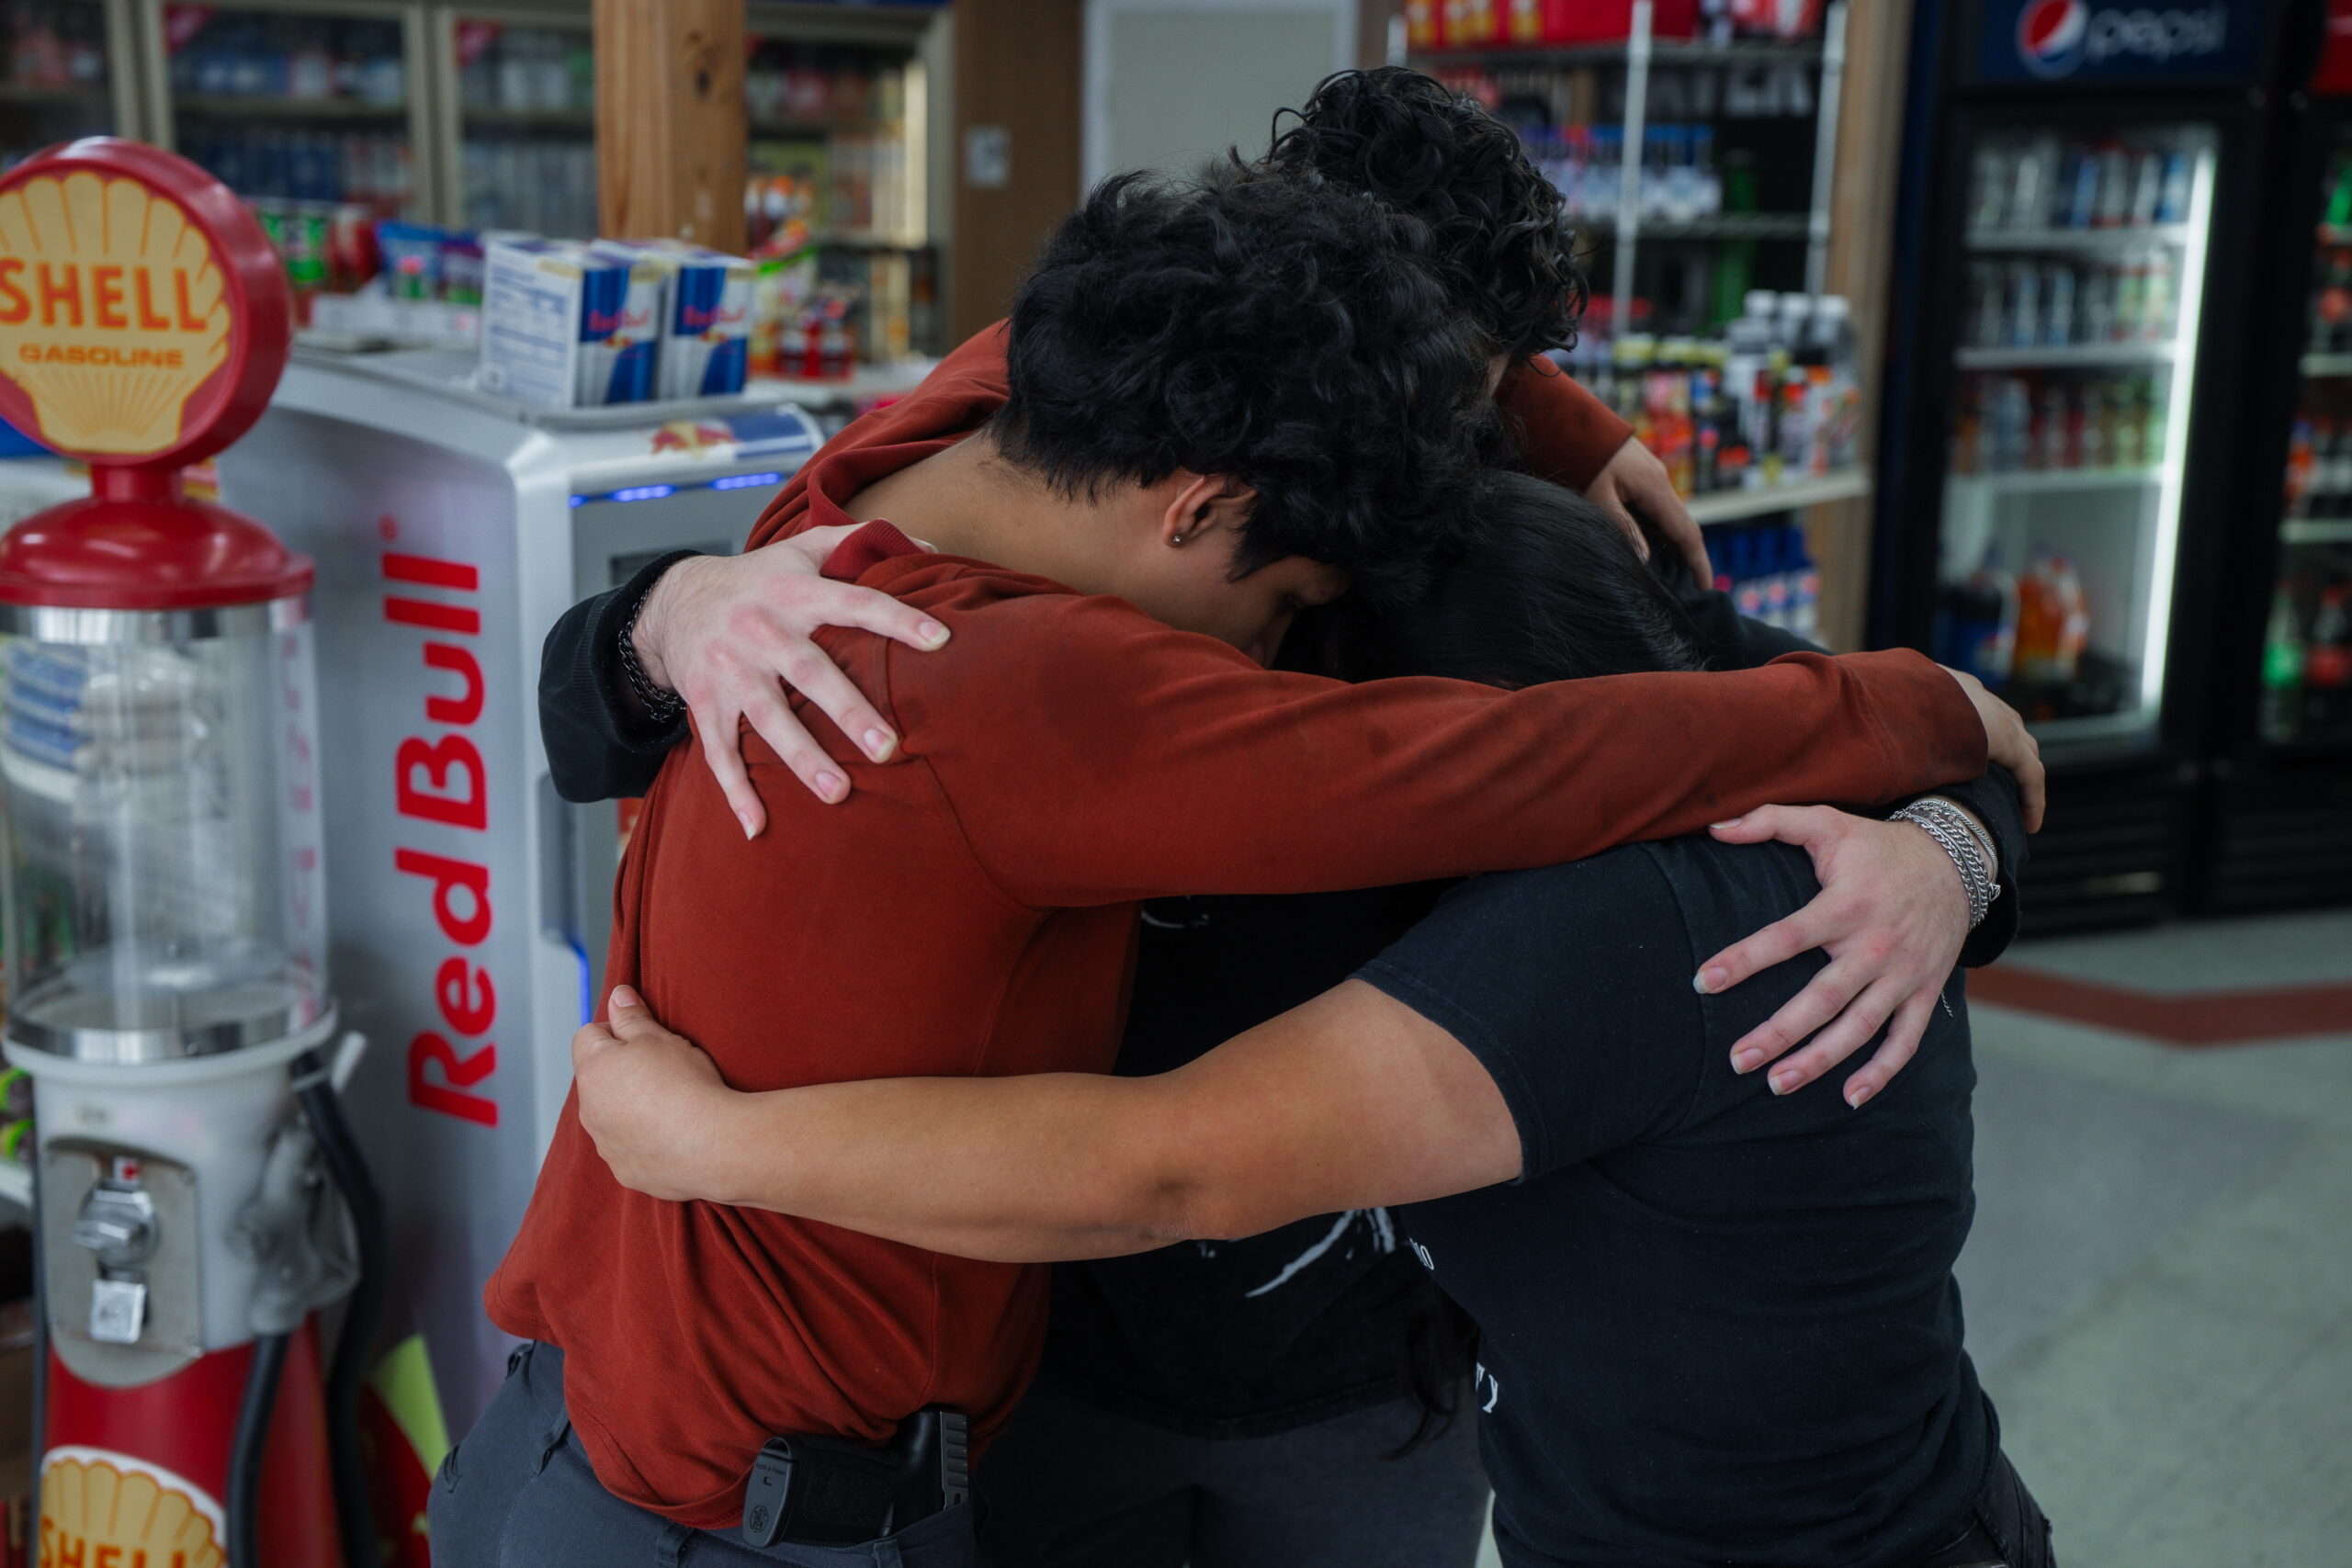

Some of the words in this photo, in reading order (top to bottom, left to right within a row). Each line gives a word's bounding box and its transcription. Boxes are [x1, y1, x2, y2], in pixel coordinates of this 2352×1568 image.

[0, 256, 209, 333] SHELL
[18, 344, 185, 368] GASOLINE
[381, 551, 488, 830] Bull
[395, 846, 499, 1128] Red
